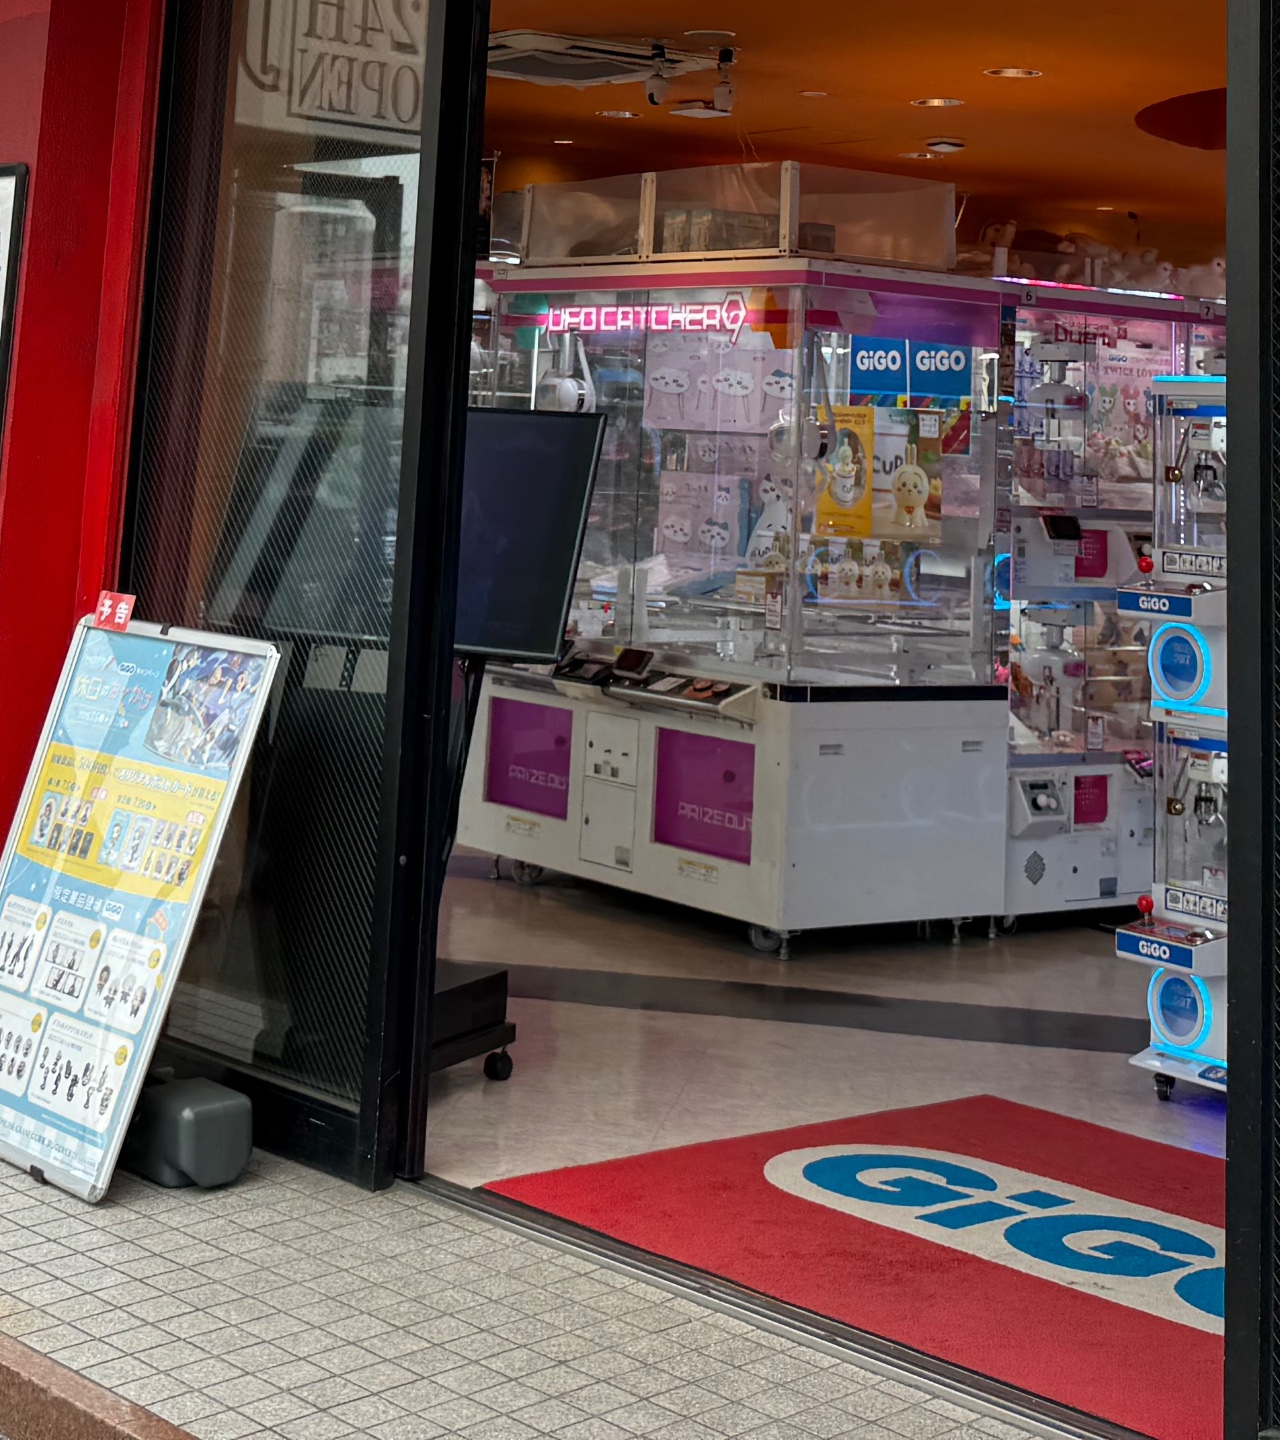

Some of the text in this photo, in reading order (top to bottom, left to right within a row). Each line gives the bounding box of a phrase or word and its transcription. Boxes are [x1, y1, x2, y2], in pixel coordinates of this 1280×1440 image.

[1026, 291, 1033, 302] 6
[1205, 306, 1211, 317] 7
[856, 349, 966, 372] GiGO GiGO
[100, 599, 130, 624] 予告
[1138, 595, 1170, 612] GiGO
[1138, 940, 1171, 960] GiGO
